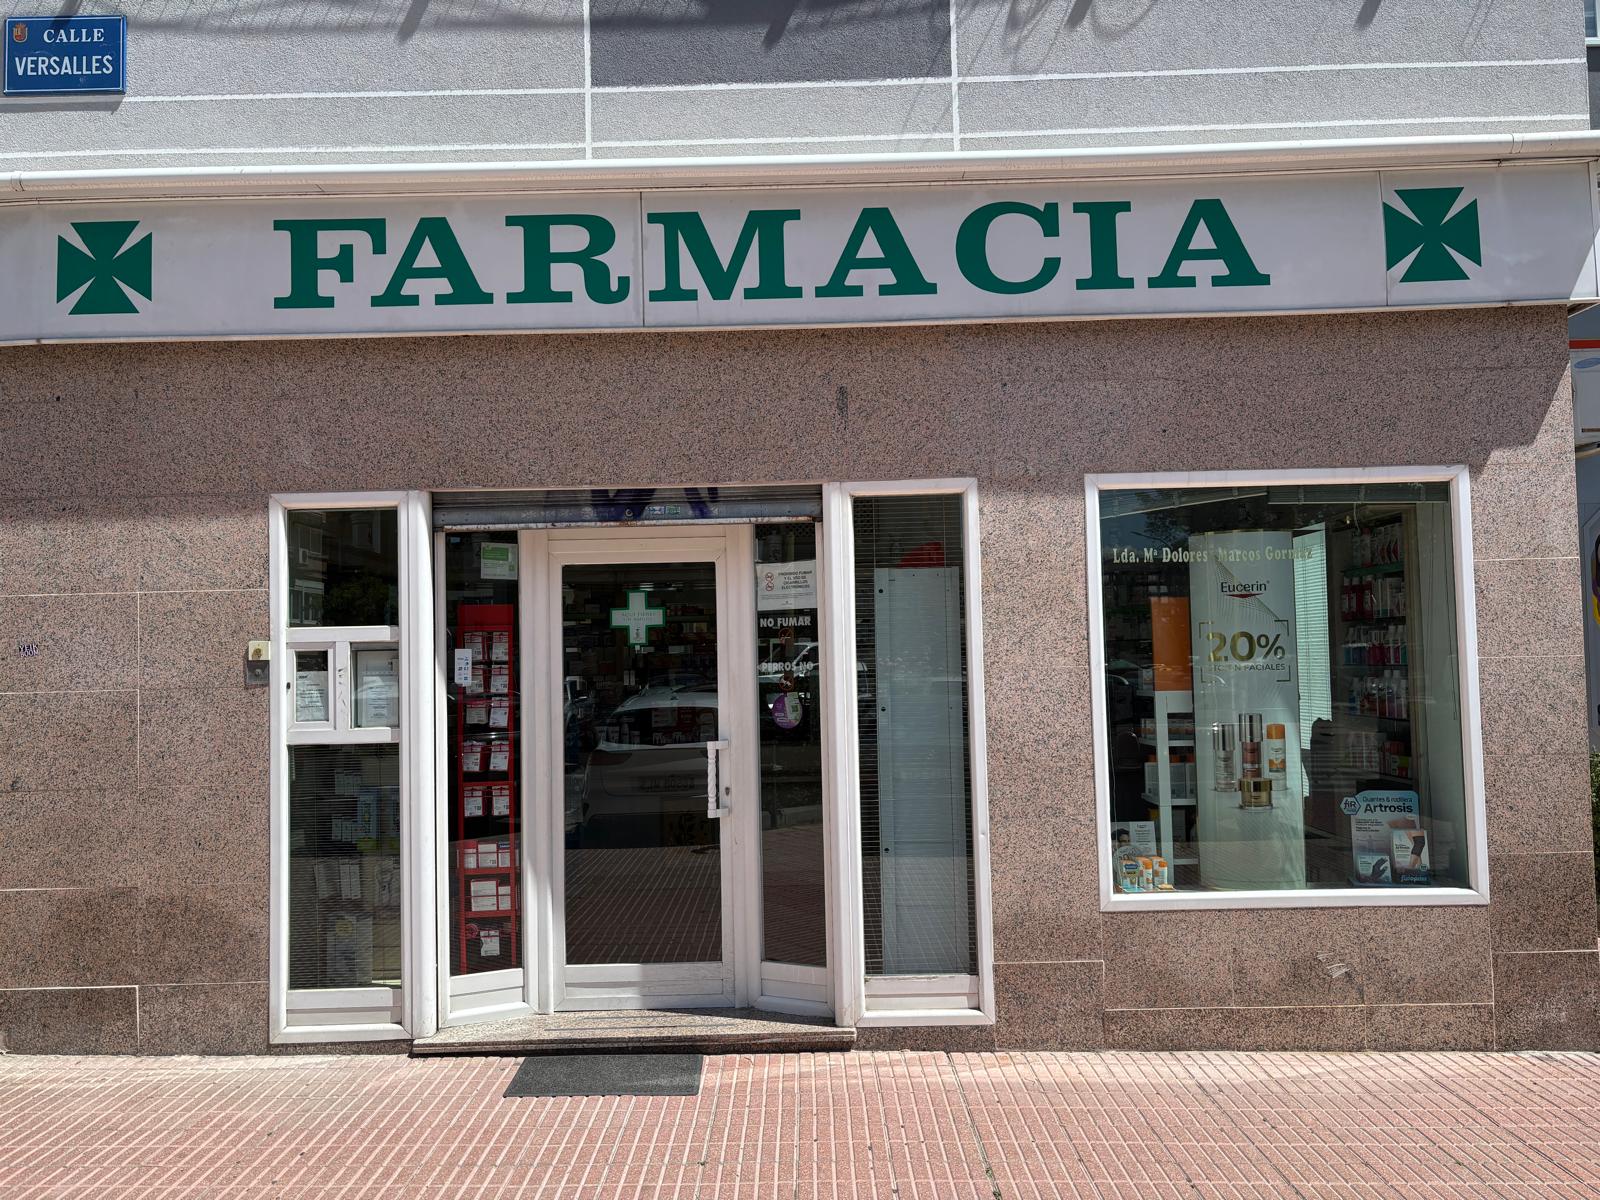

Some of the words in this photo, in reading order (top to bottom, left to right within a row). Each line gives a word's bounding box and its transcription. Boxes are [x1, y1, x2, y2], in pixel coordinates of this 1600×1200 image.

[43, 28, 105, 43] CALLE
[15, 54, 113, 76] VERSALLES
[274, 199, 1270, 308] FARMACIA
[1112, 547, 1140, 564] Lda.
[1162, 547, 1208, 563] Dolores
[1218, 547, 1260, 562] Marcos
[760, 618, 774, 628] NO
[777, 616, 812, 627] FUMAR
[1207, 631, 1286, 662] 20%
[761, 662, 797, 673] PERROS
[1244, 663, 1286, 672] FACIALES
[1364, 803, 1413, 814] Artrosis
